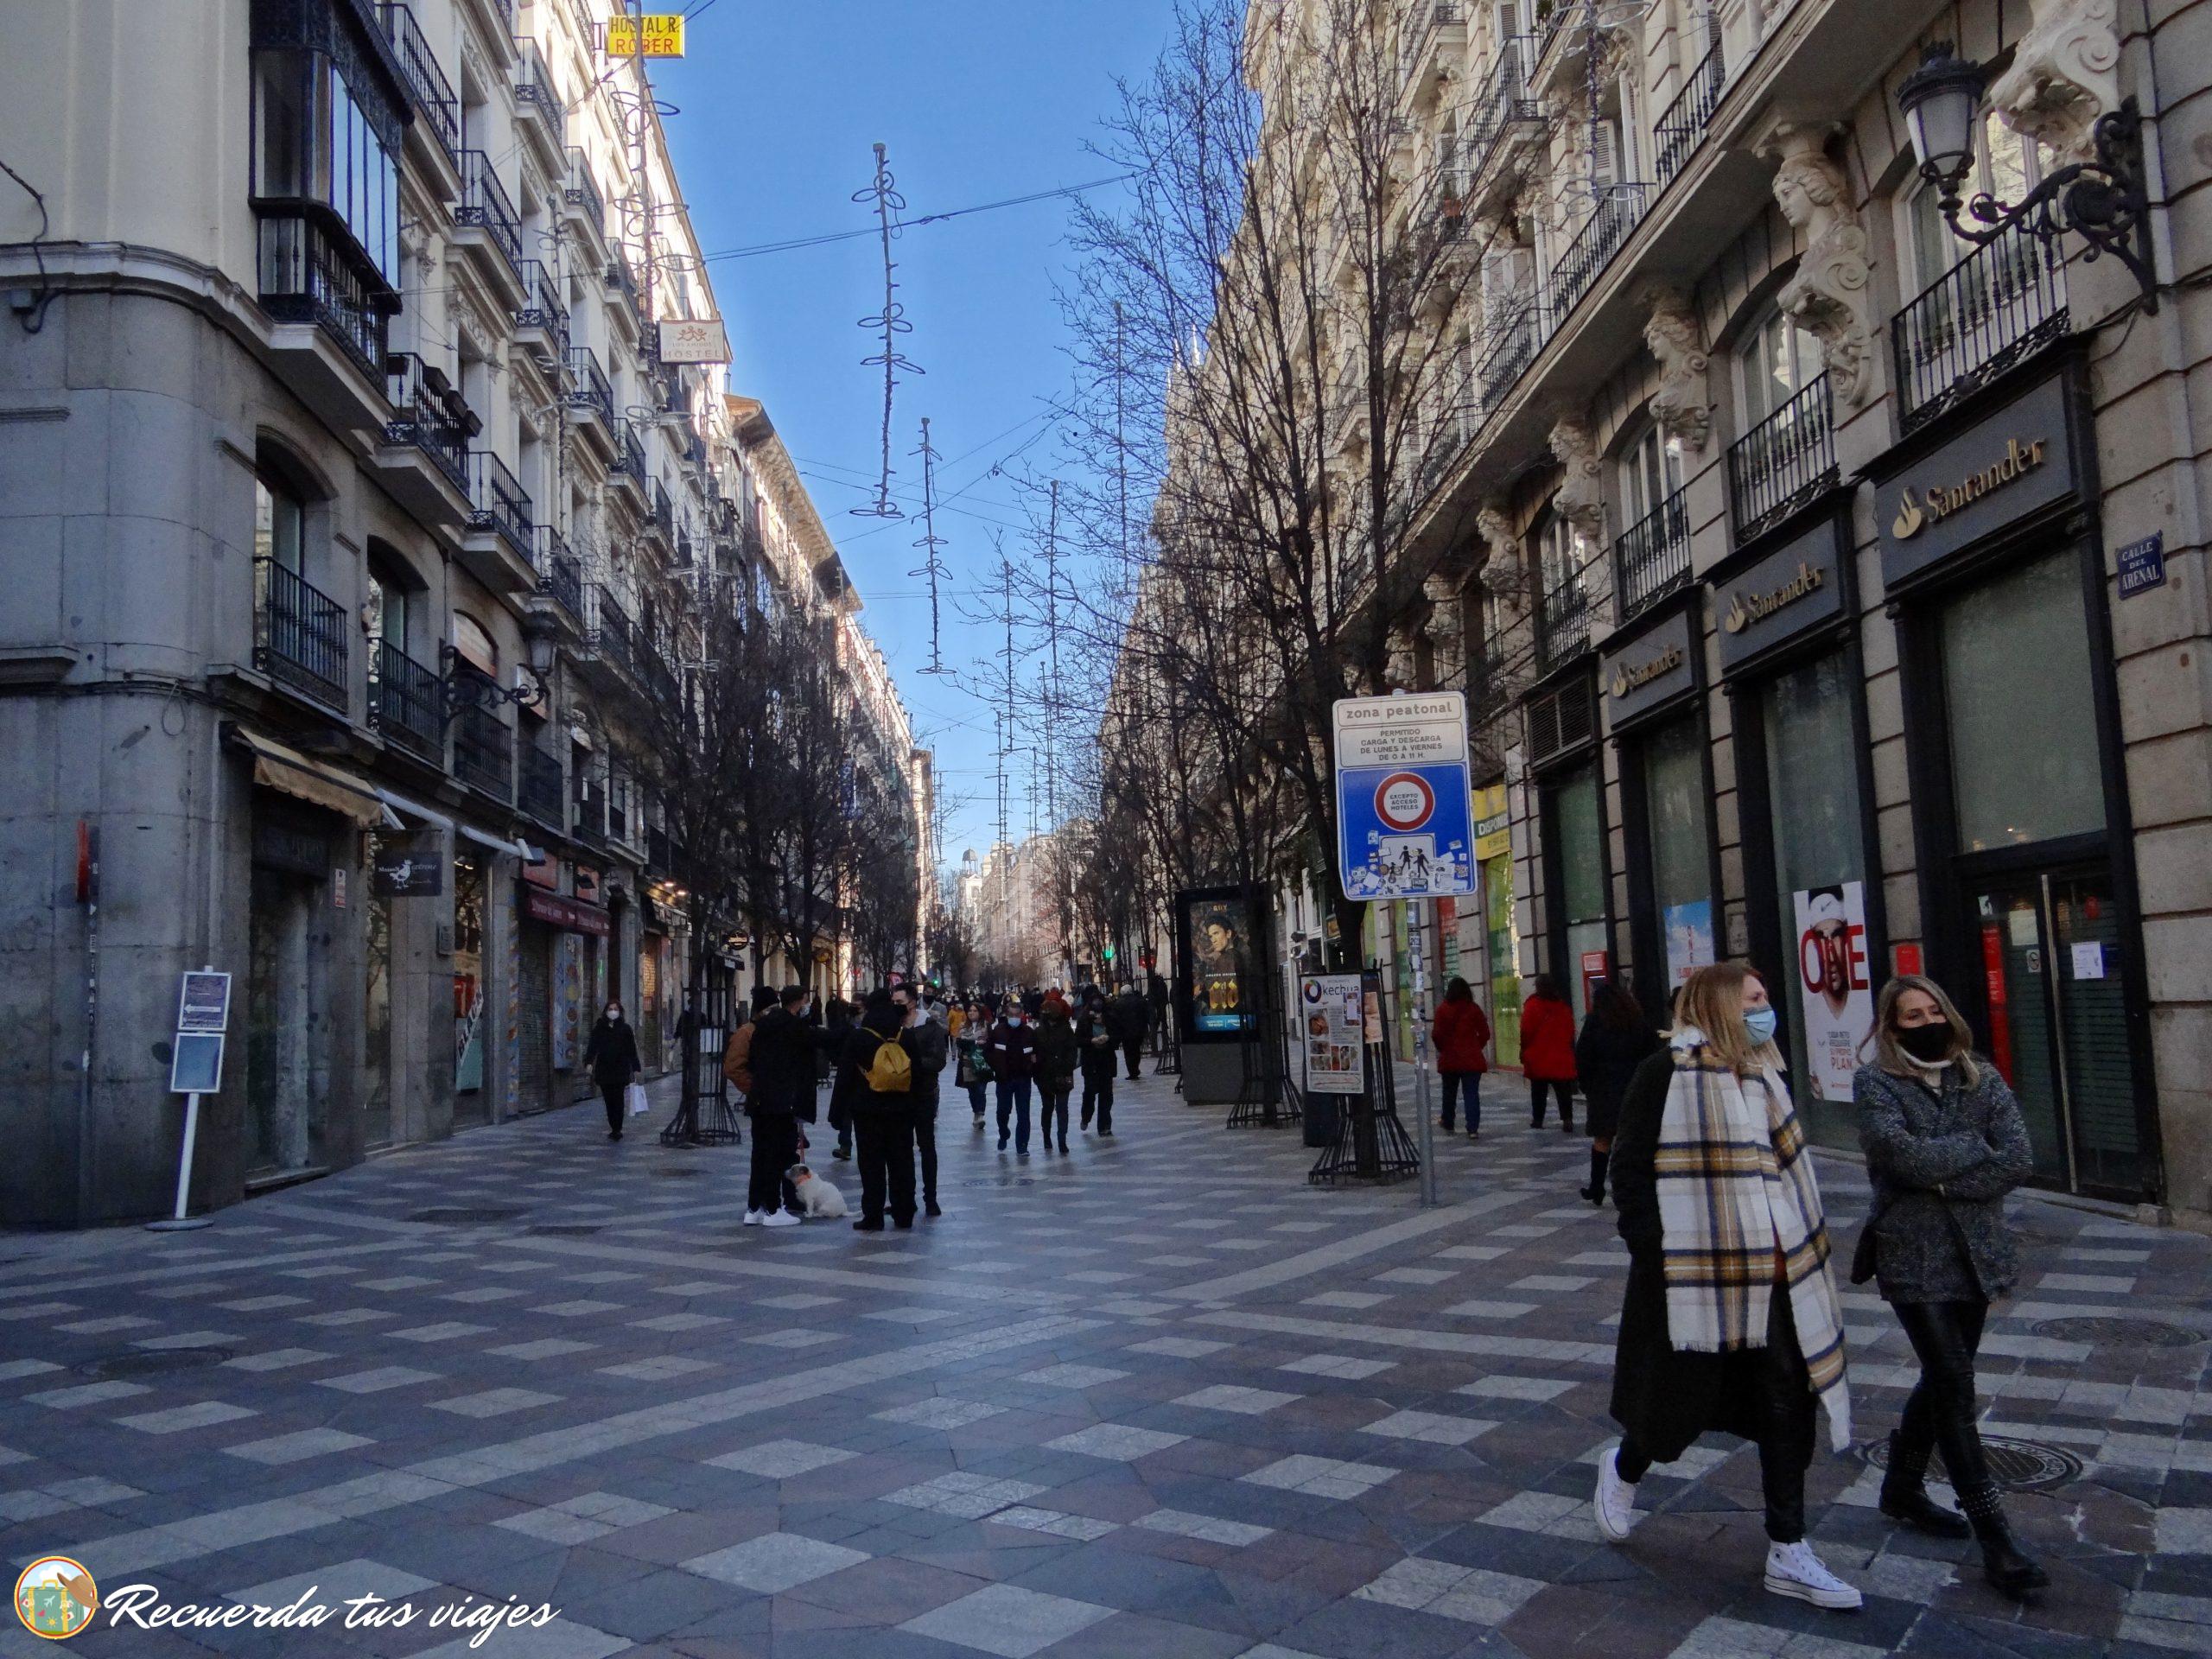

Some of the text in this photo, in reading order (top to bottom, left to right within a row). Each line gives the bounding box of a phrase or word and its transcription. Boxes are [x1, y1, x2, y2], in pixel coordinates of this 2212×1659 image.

[610, 16, 663, 34] HOSTAL
[616, 38, 673, 53] ROBER
[1926, 438, 2046, 523] Santander
[2121, 542, 2153, 562] CALLE
[2129, 557, 2146, 569] DEL
[2122, 564, 2160, 590] ARENAL
[1748, 561, 1822, 623] Santander
[1628, 643, 1682, 690] Santander
[1346, 701, 1452, 719] zona peatonal
[1380, 728, 1421, 737] PERMITIDO
[1398, 735, 1441, 744] DESCARGA
[1410, 742, 1443, 751] VIERNES
[1801, 924, 1869, 995] ONE
